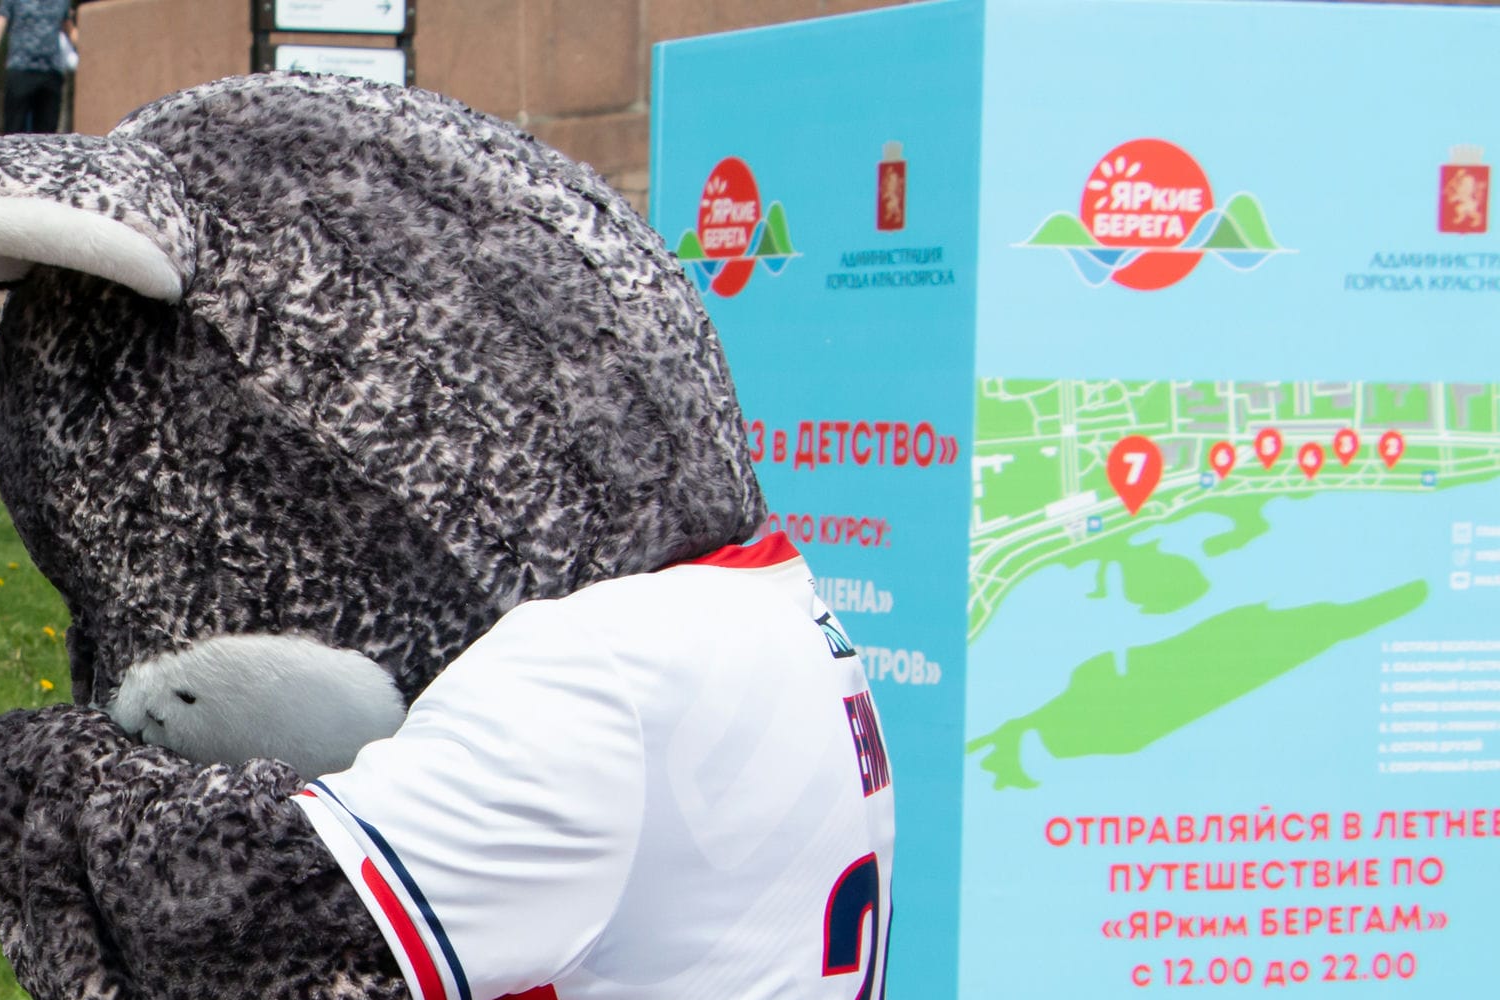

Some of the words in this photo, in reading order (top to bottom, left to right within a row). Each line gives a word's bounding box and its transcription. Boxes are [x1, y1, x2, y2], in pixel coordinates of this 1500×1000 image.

[1110, 182, 1202, 211] ЯРКИЕ
[703, 227, 747, 249] БЕРЕГА
[1094, 214, 1184, 239] БЕРЕГА
[794, 420, 959, 471] ДЕТСТВО»
[1385, 437, 1399, 456] 2
[1121, 451, 1148, 485] 7
[819, 514, 891, 548] КУРСУ:
[1045, 805, 1329, 847] ОТПРАВЛЯЙСЯ
[1343, 812, 1362, 840] В
[1109, 859, 1379, 892] ПУТЕШЕСТВИЕ
[1392, 857, 1445, 886] ПО
[1260, 905, 1448, 936] БЕРЕГАМ»
[1163, 958, 1253, 986] 12.00
[1264, 960, 1310, 988] до
[1321, 952, 1417, 982] 22.00
